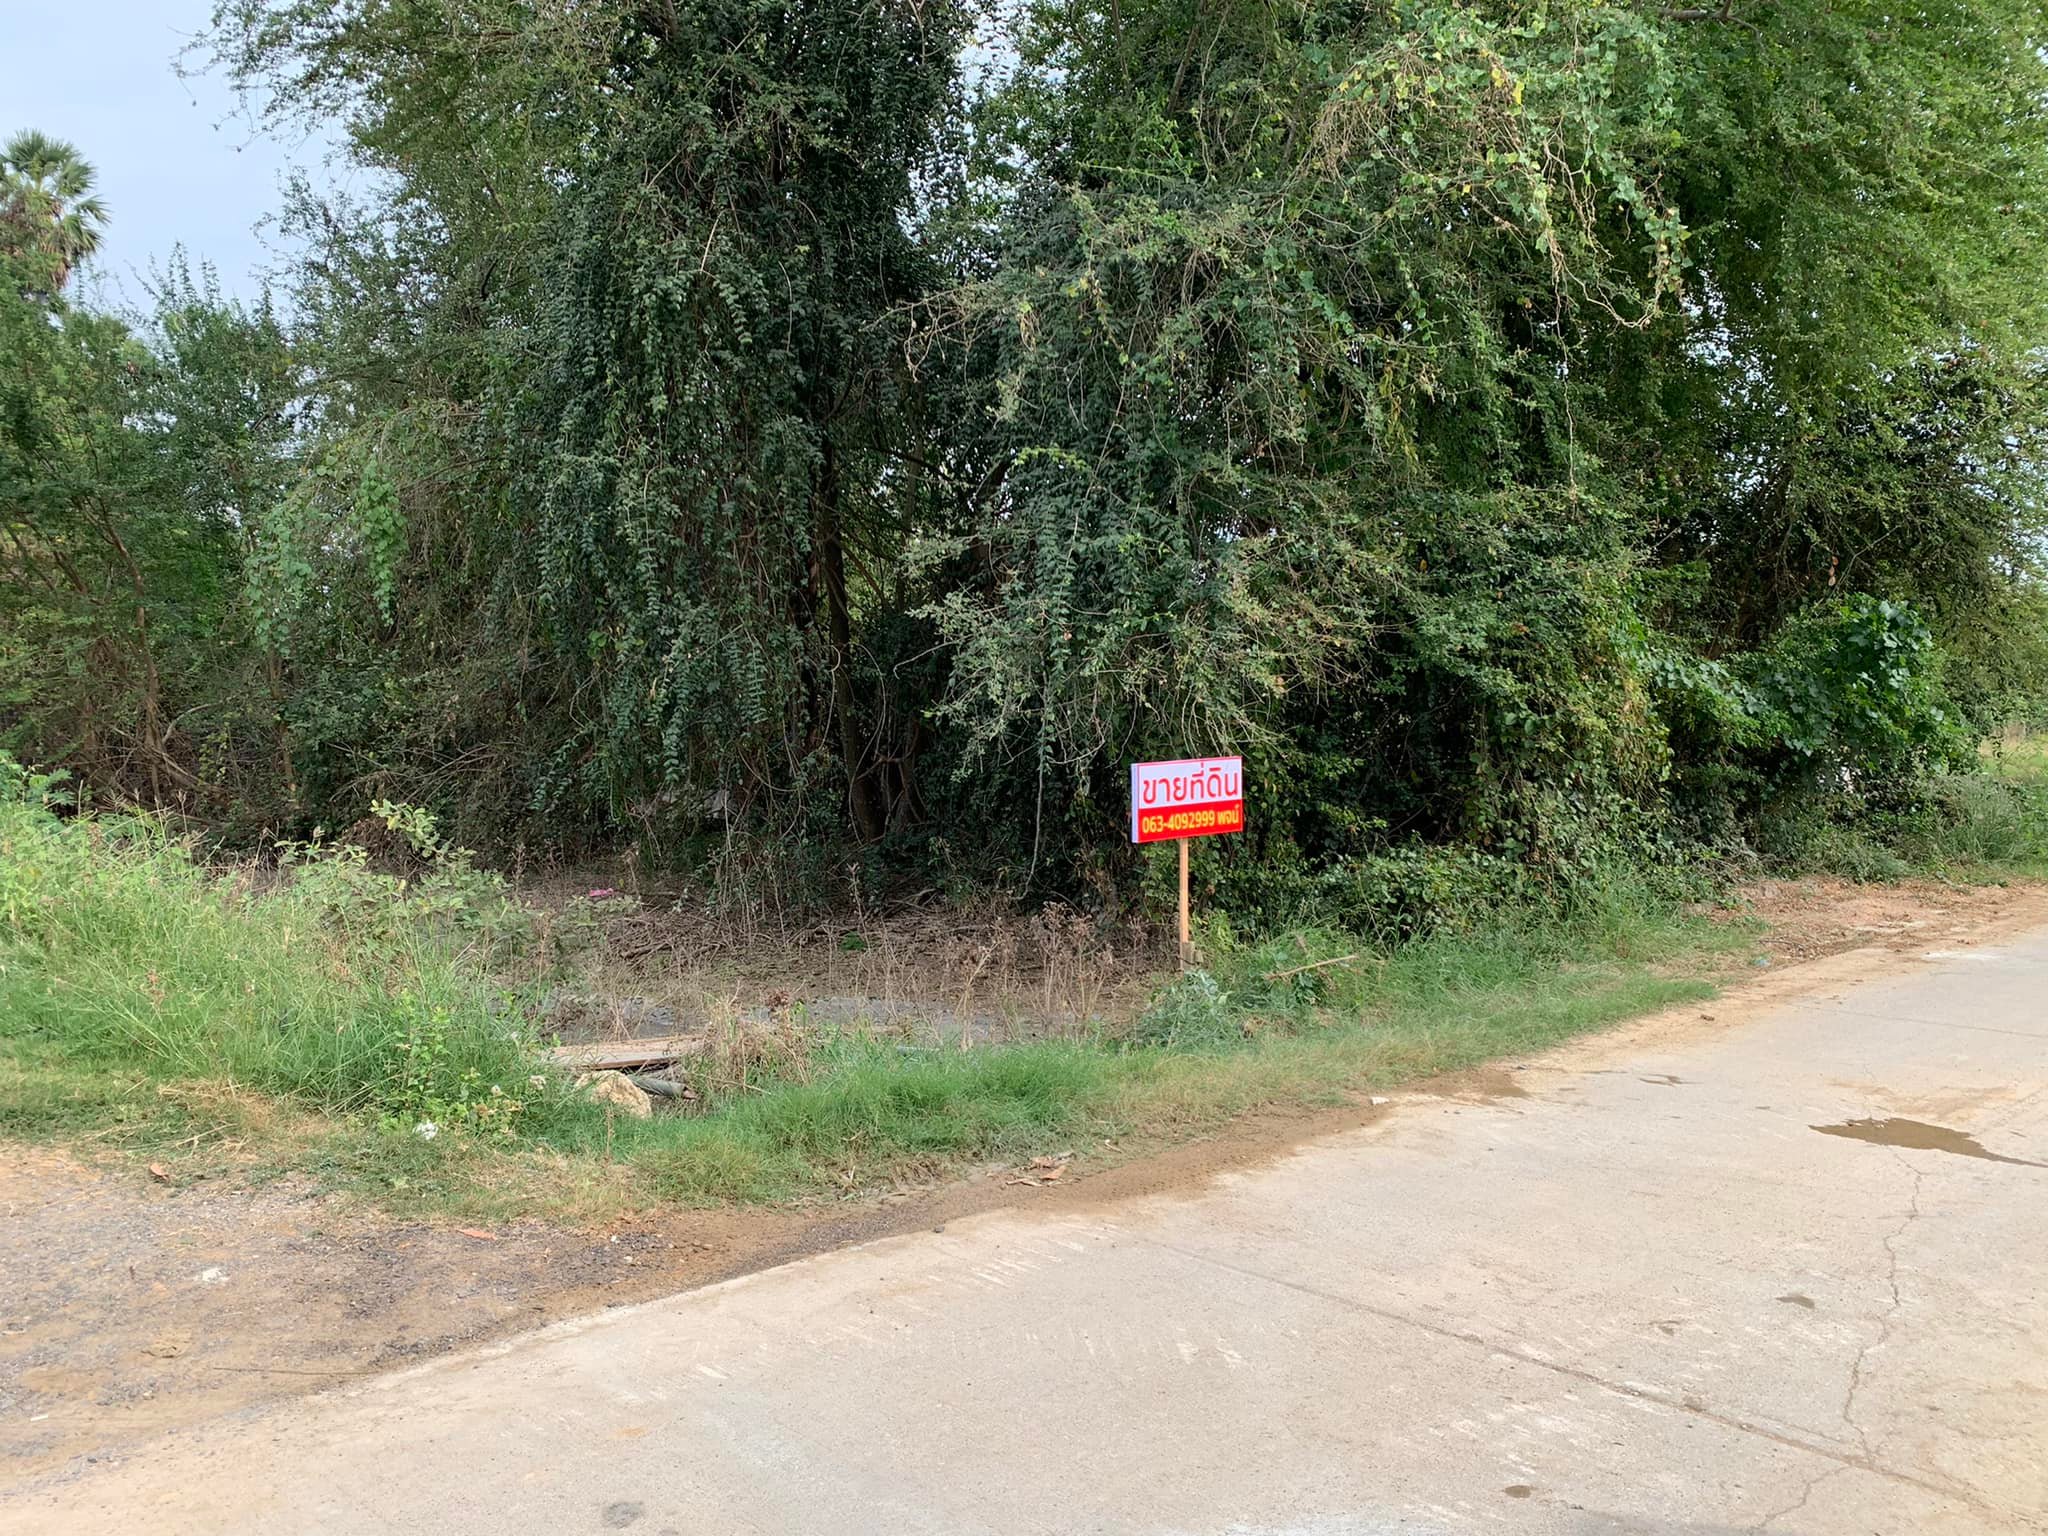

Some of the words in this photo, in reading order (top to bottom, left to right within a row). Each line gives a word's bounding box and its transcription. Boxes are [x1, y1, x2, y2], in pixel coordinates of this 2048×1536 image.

[1143, 762, 1238, 804] ขายที่ดิน
[1142, 810, 1215, 834] 063-4092999
